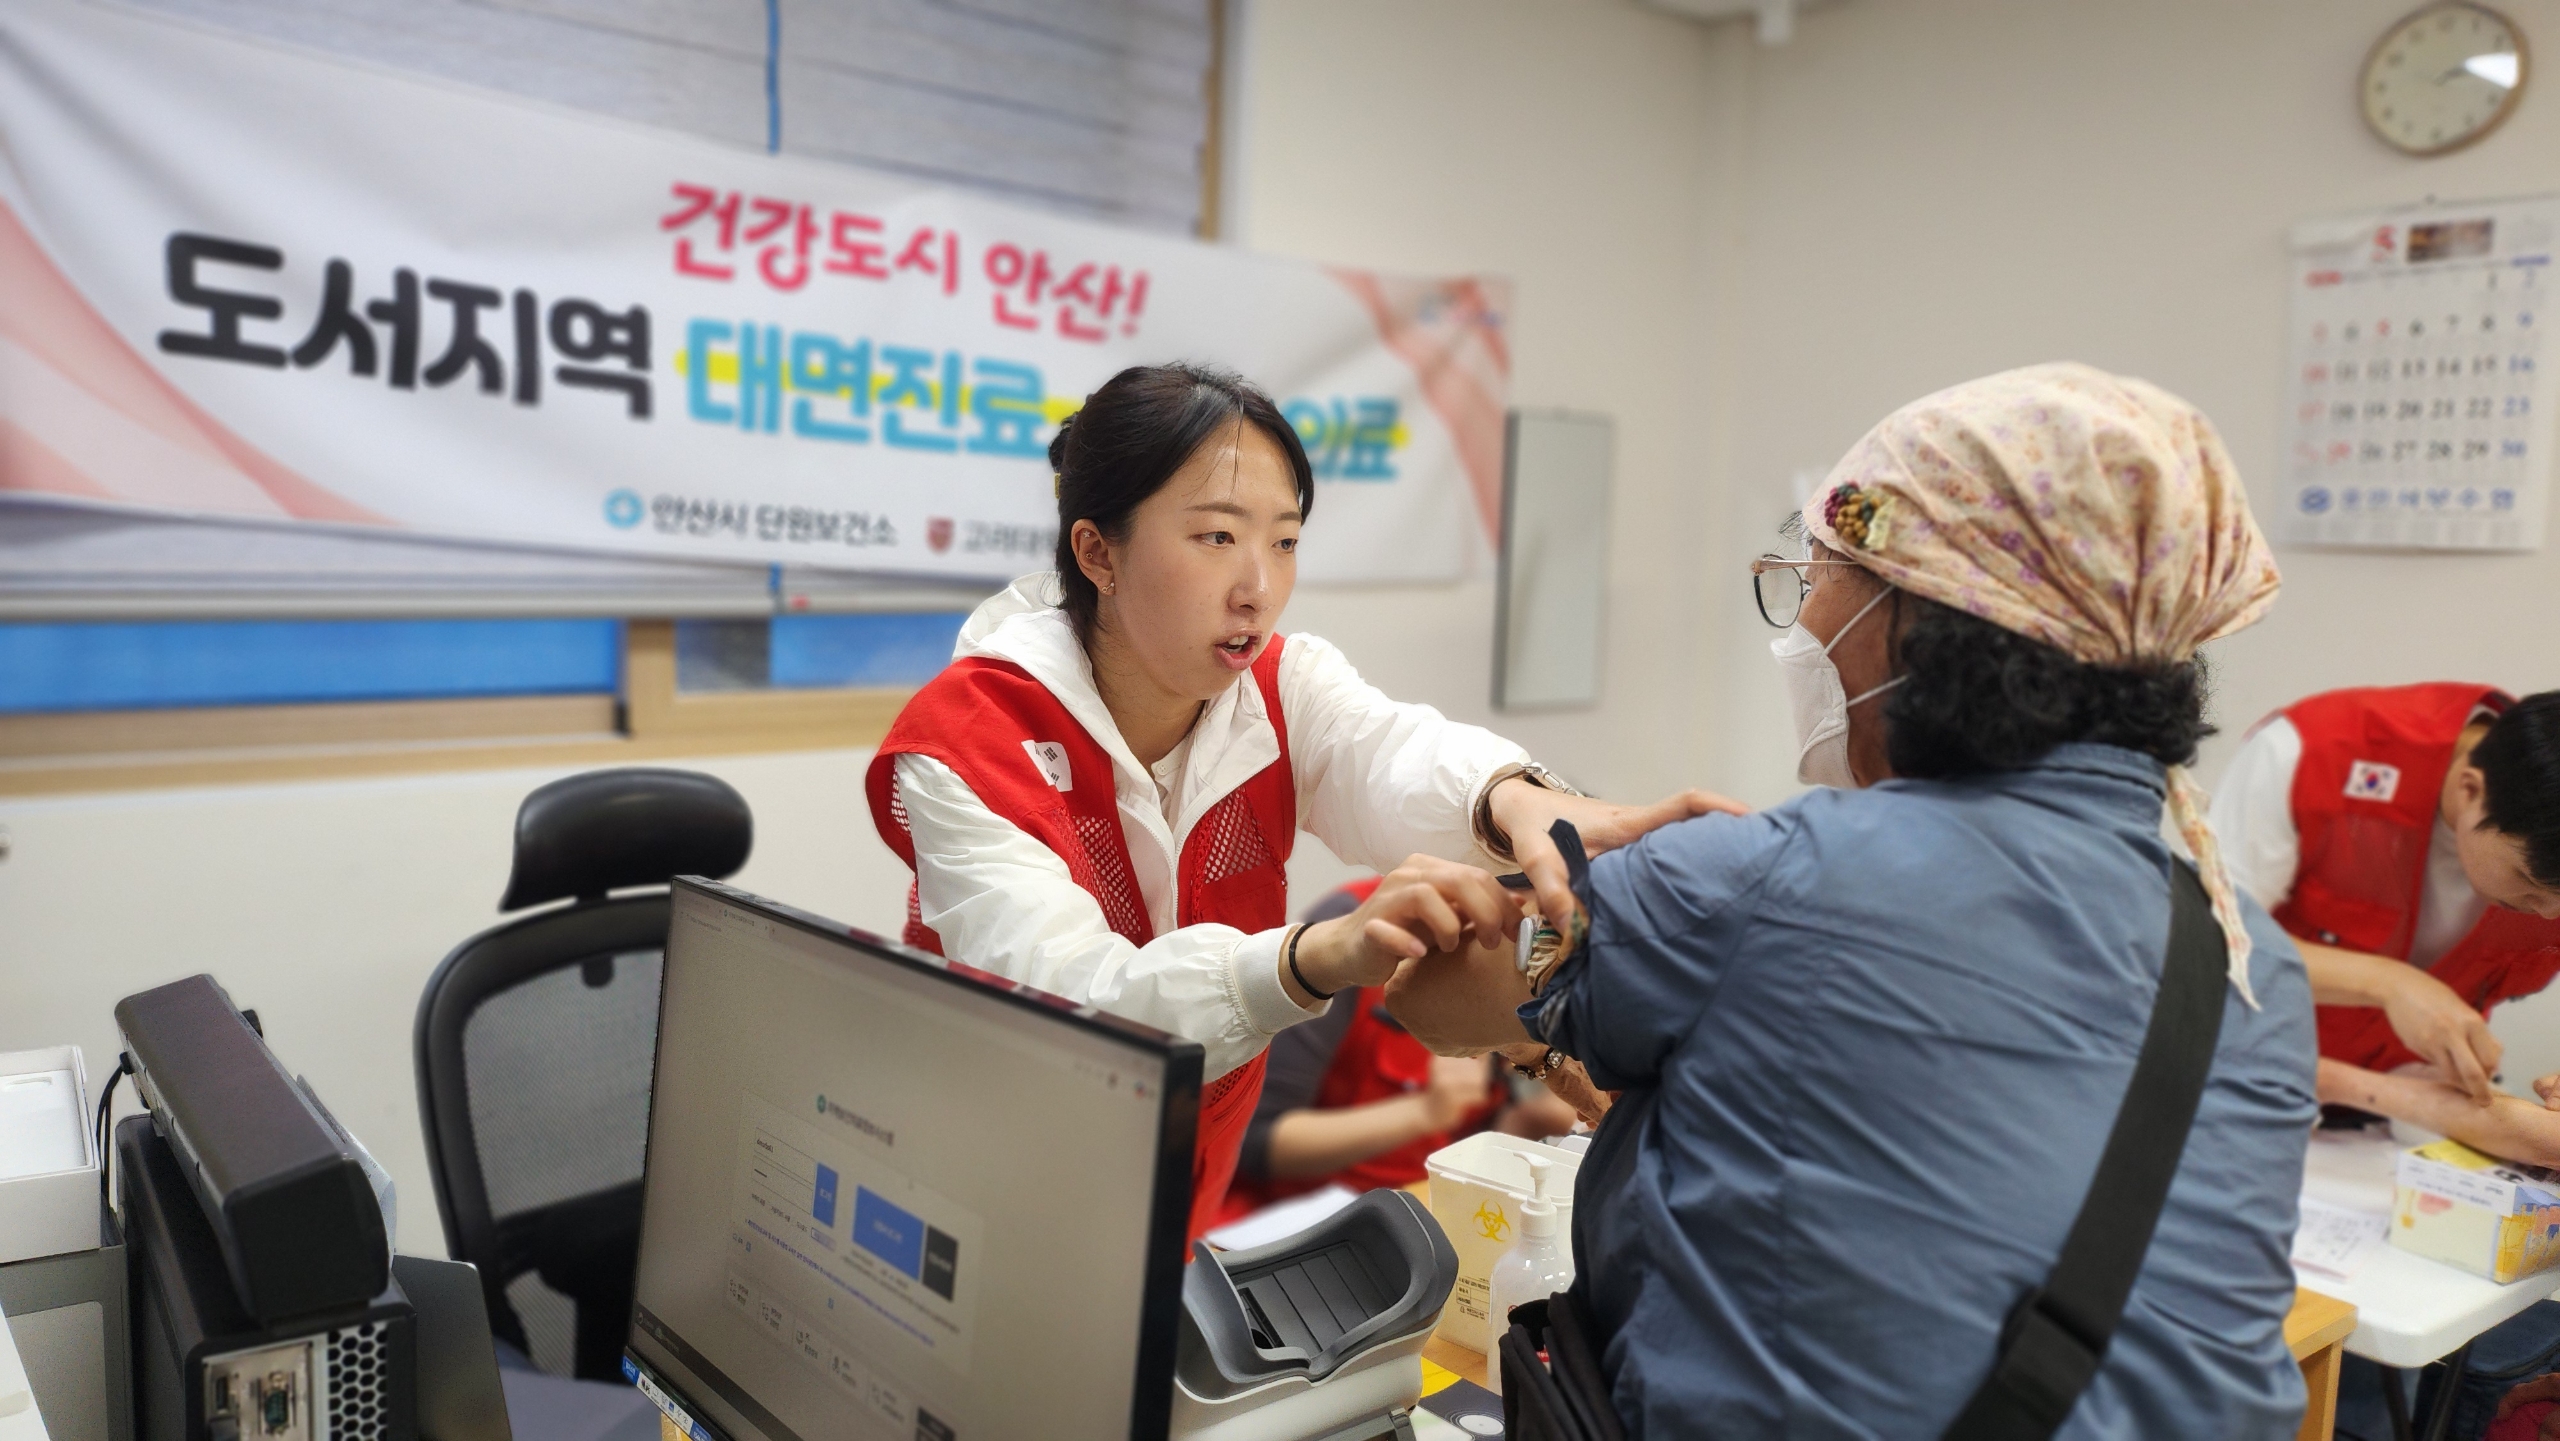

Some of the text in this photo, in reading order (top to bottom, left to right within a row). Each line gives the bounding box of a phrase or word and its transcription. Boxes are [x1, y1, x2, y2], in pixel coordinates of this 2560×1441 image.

[660, 181, 1151, 344] 건강도시 안산!
[156, 231, 653, 421] 도서지역
[686, 317, 1050, 461] 대면진료
[651, 493, 898, 547] 안산시 단원보건소
